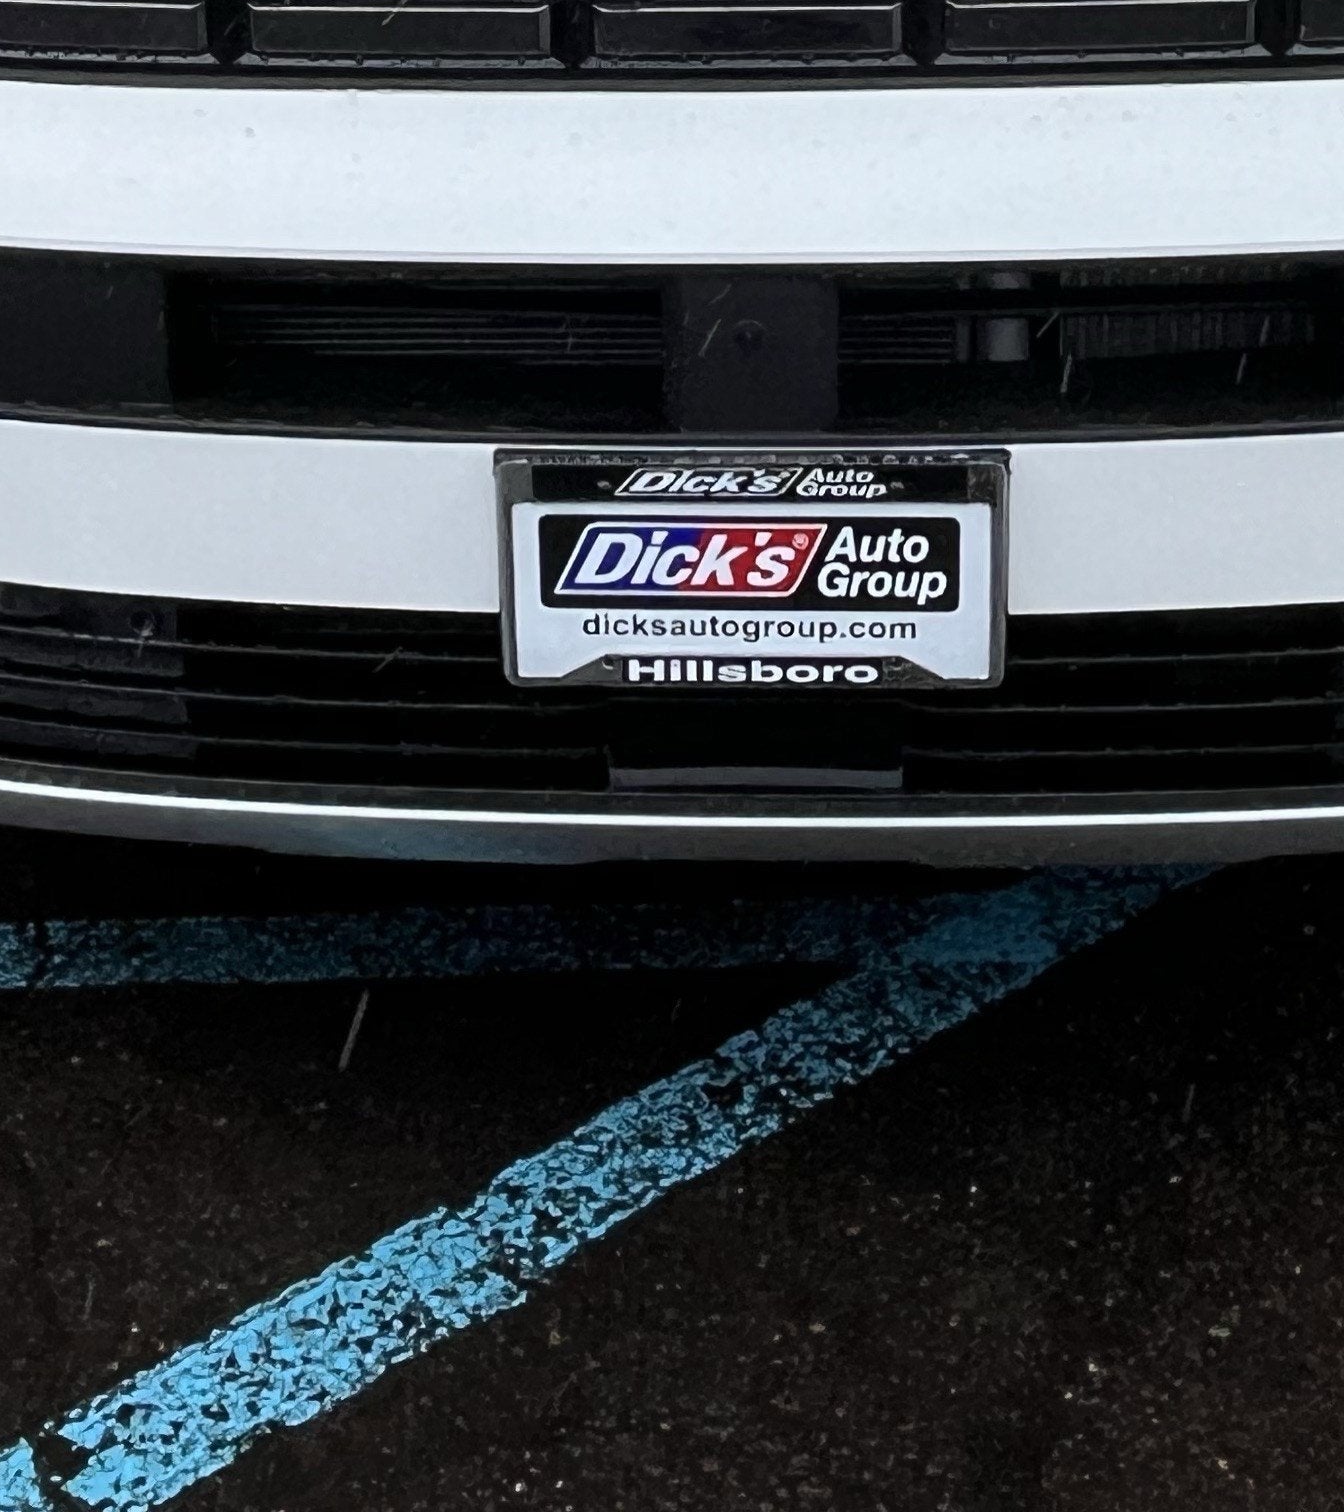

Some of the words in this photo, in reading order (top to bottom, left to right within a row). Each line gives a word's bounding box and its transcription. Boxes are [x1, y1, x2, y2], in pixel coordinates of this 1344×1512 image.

[628, 469, 784, 493] Dick's
[806, 467, 875, 484] Auto
[796, 480, 888, 499] Group
[574, 530, 796, 587] Dick's
[825, 526, 930, 564] Auto
[817, 561, 948, 606] Group
[582, 613, 917, 644] dicksautogroup.com
[628, 659, 880, 683] Hillsboro
